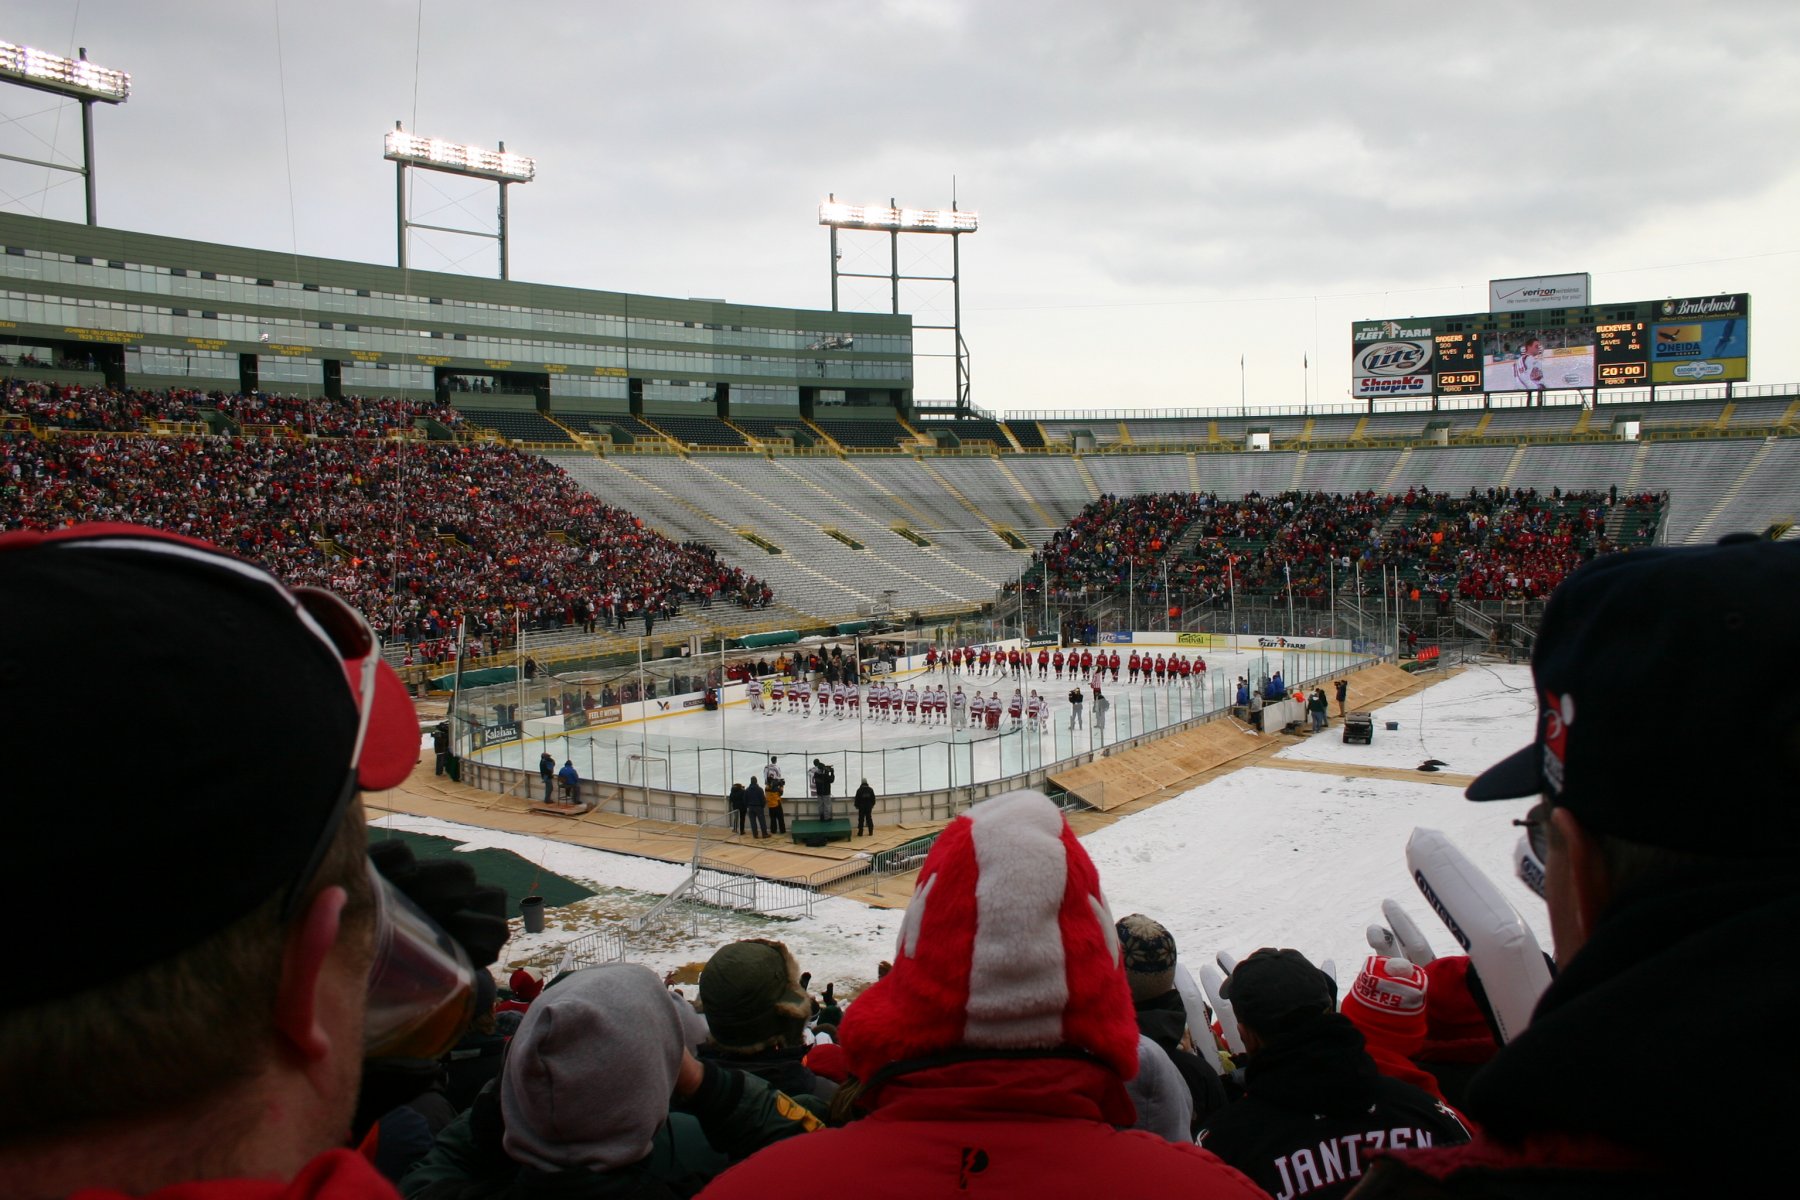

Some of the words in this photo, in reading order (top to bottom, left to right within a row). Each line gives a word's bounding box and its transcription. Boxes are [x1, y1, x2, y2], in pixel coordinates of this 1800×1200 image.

[1522, 288, 1556, 297] verizon
[1676, 296, 1736, 315] Brakebush
[1596, 323, 1632, 333] BUCKEYES
[1355, 331, 1385, 340] FLEET
[1400, 328, 1431, 338] FARM
[1435, 334, 1463, 343] BADGERS
[1656, 342, 1700, 352] ONEIDA
[1367, 349, 1421, 369] Lite
[1602, 366, 1641, 376] 20:00
[1441, 374, 1475, 384] 20:00
[1360, 376, 1424, 393] ShopKo
[485, 726, 518, 742] Kalahari
